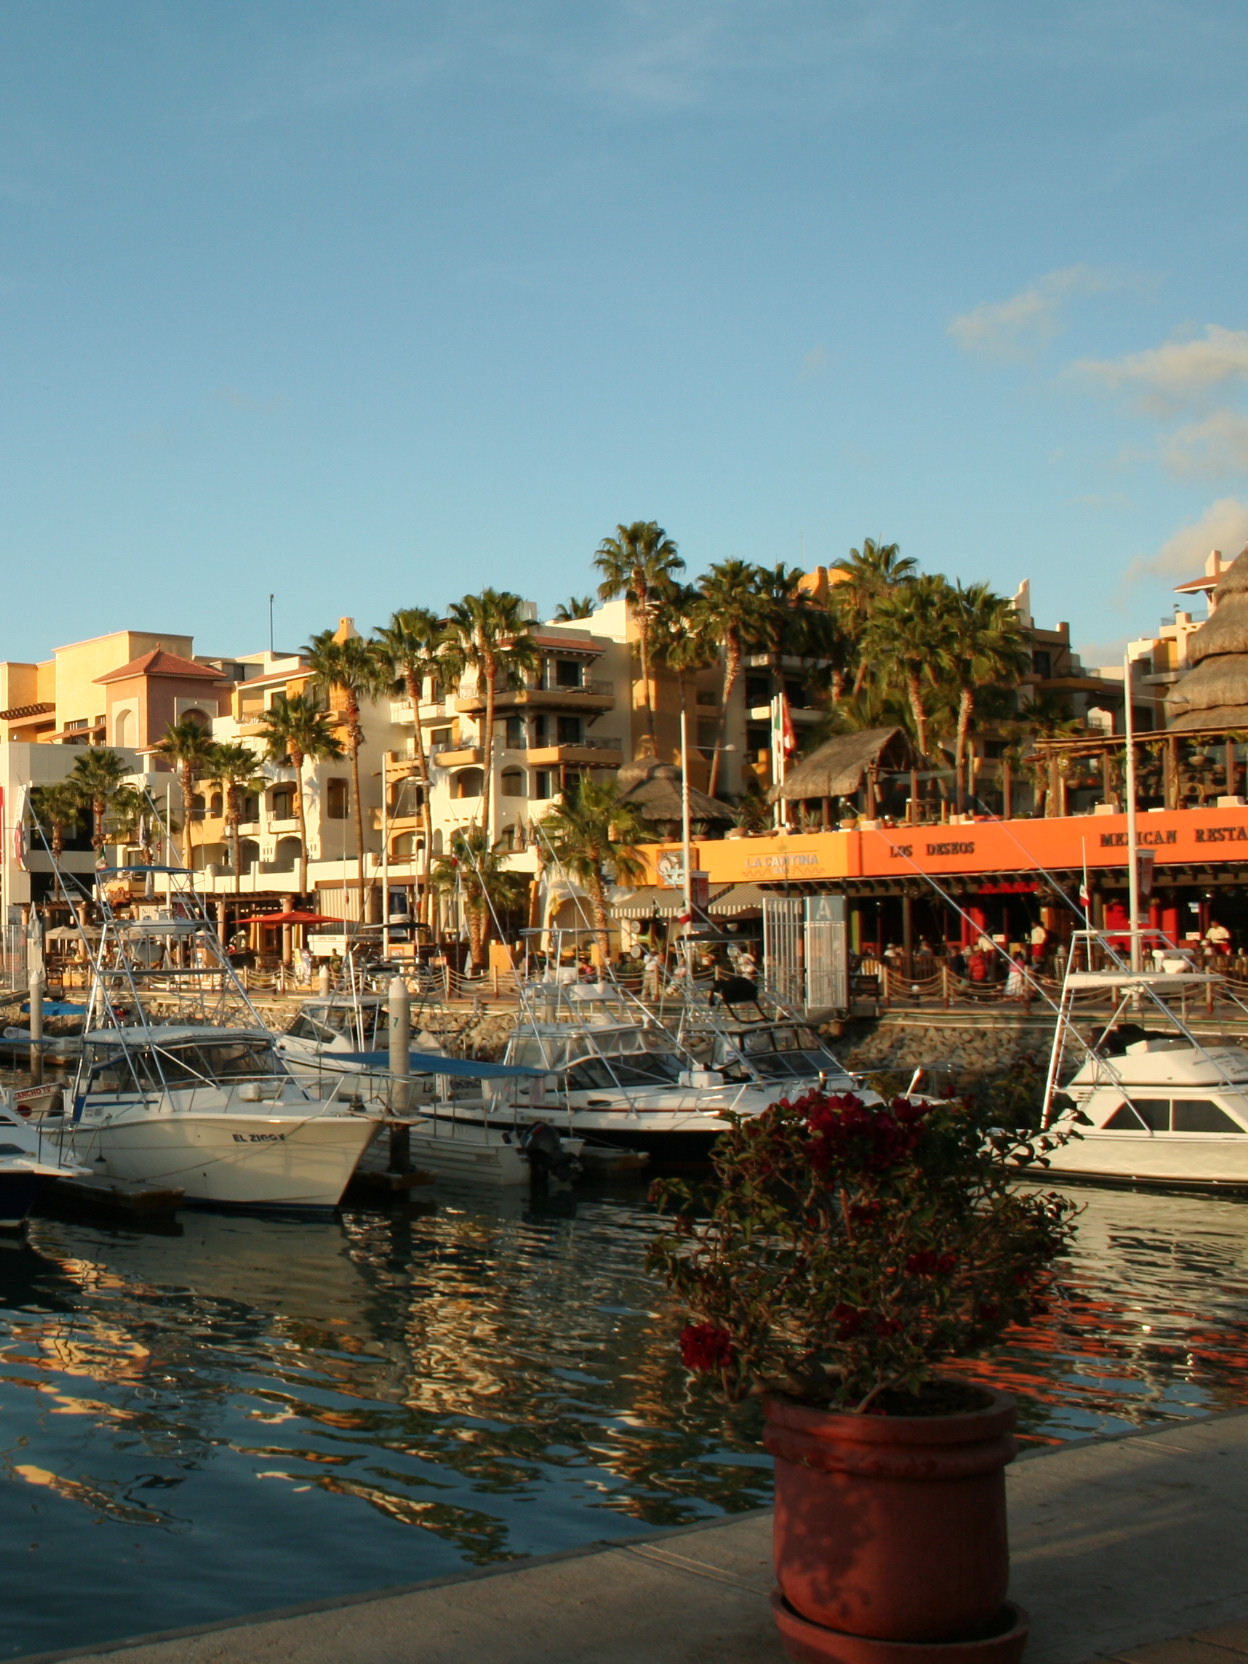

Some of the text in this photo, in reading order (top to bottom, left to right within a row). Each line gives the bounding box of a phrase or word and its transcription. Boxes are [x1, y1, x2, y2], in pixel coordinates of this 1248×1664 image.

[1100, 830, 1177, 847] MEICAN
[890, 842, 975, 858] LOS DESEOS
[746, 855, 819, 868] LA CANTINA
[816, 898, 832, 920] A
[393, 1016, 399, 1028] 7
